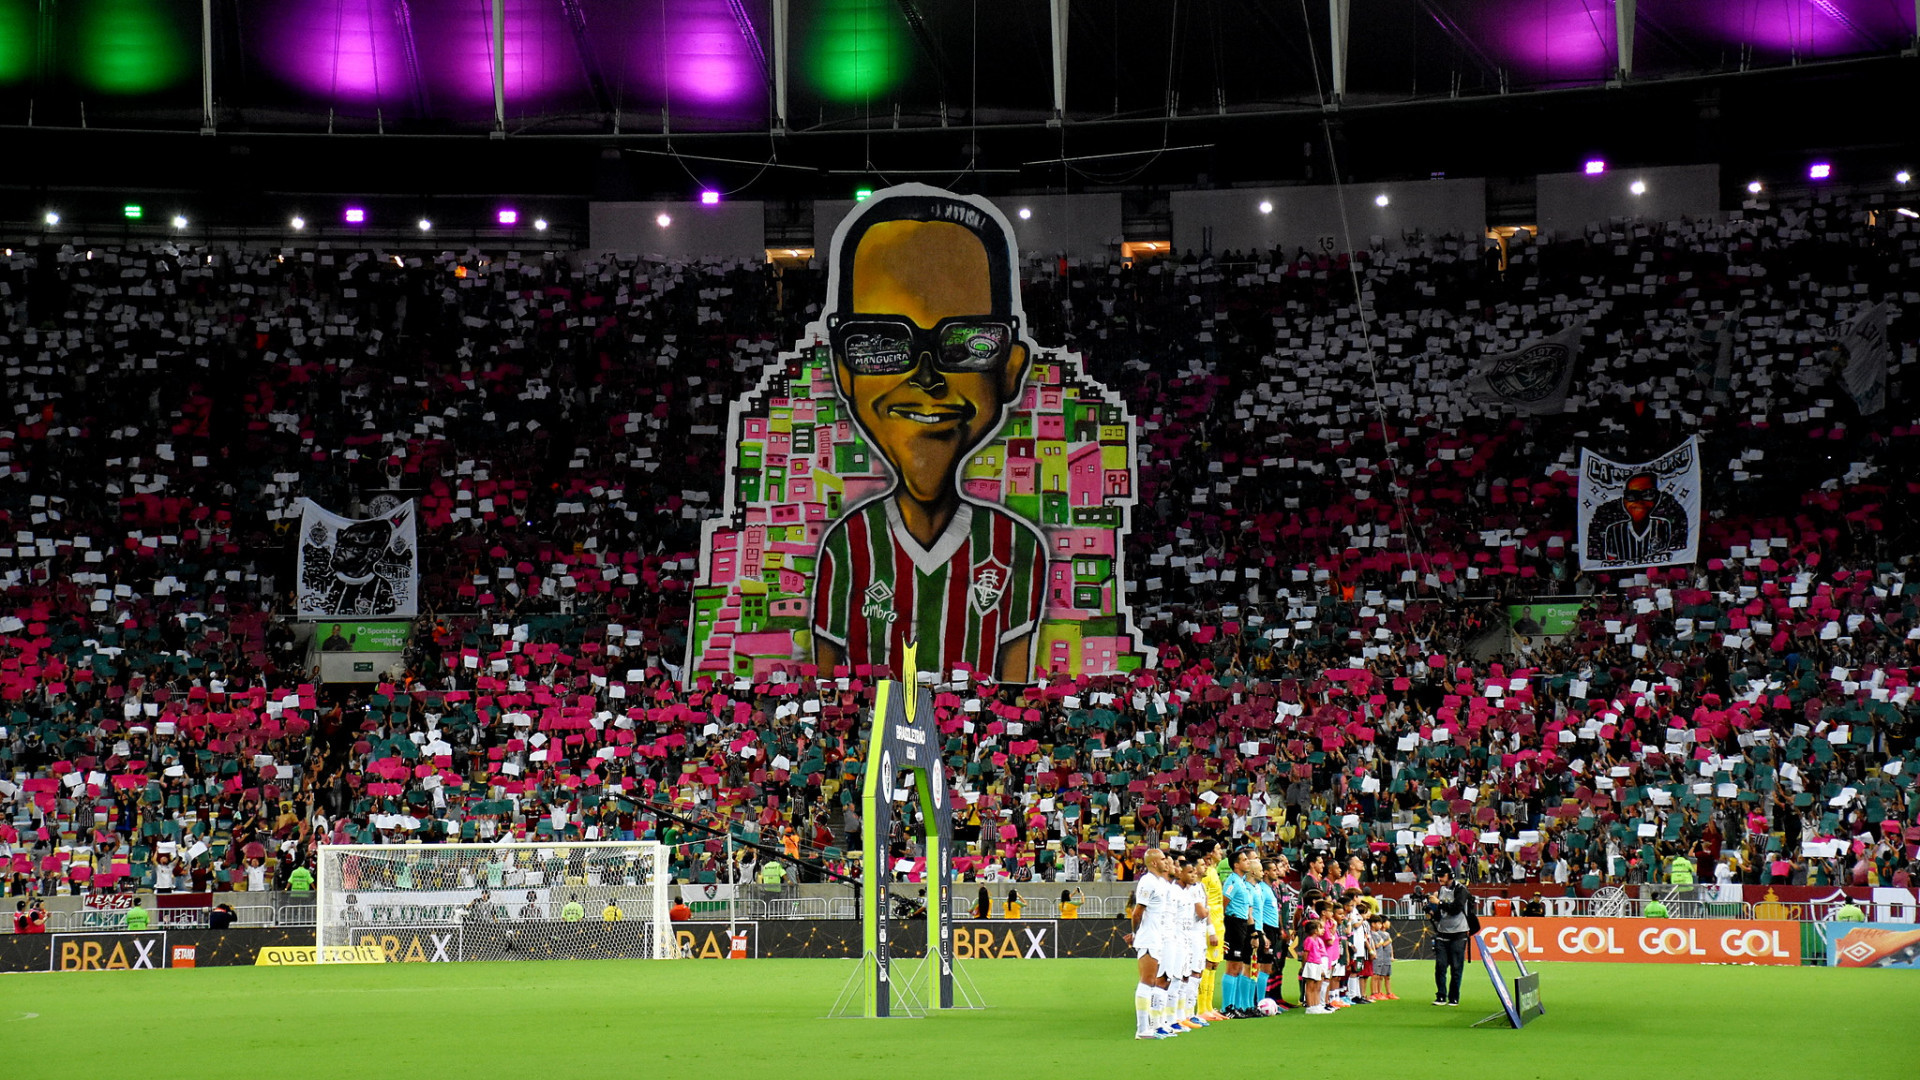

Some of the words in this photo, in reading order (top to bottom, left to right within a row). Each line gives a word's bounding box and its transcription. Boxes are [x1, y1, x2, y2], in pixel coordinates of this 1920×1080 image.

[1318, 237, 1334, 250] 15
[855, 353, 909, 365] MANGUEIRA
[953, 928, 1047, 958] BRAX
[1478, 926, 1544, 954] GOL
[1557, 926, 1624, 954] GOL
[1638, 927, 1706, 955] GOL
[1720, 928, 1790, 957] GOL
[61, 939, 156, 970] BRAX
